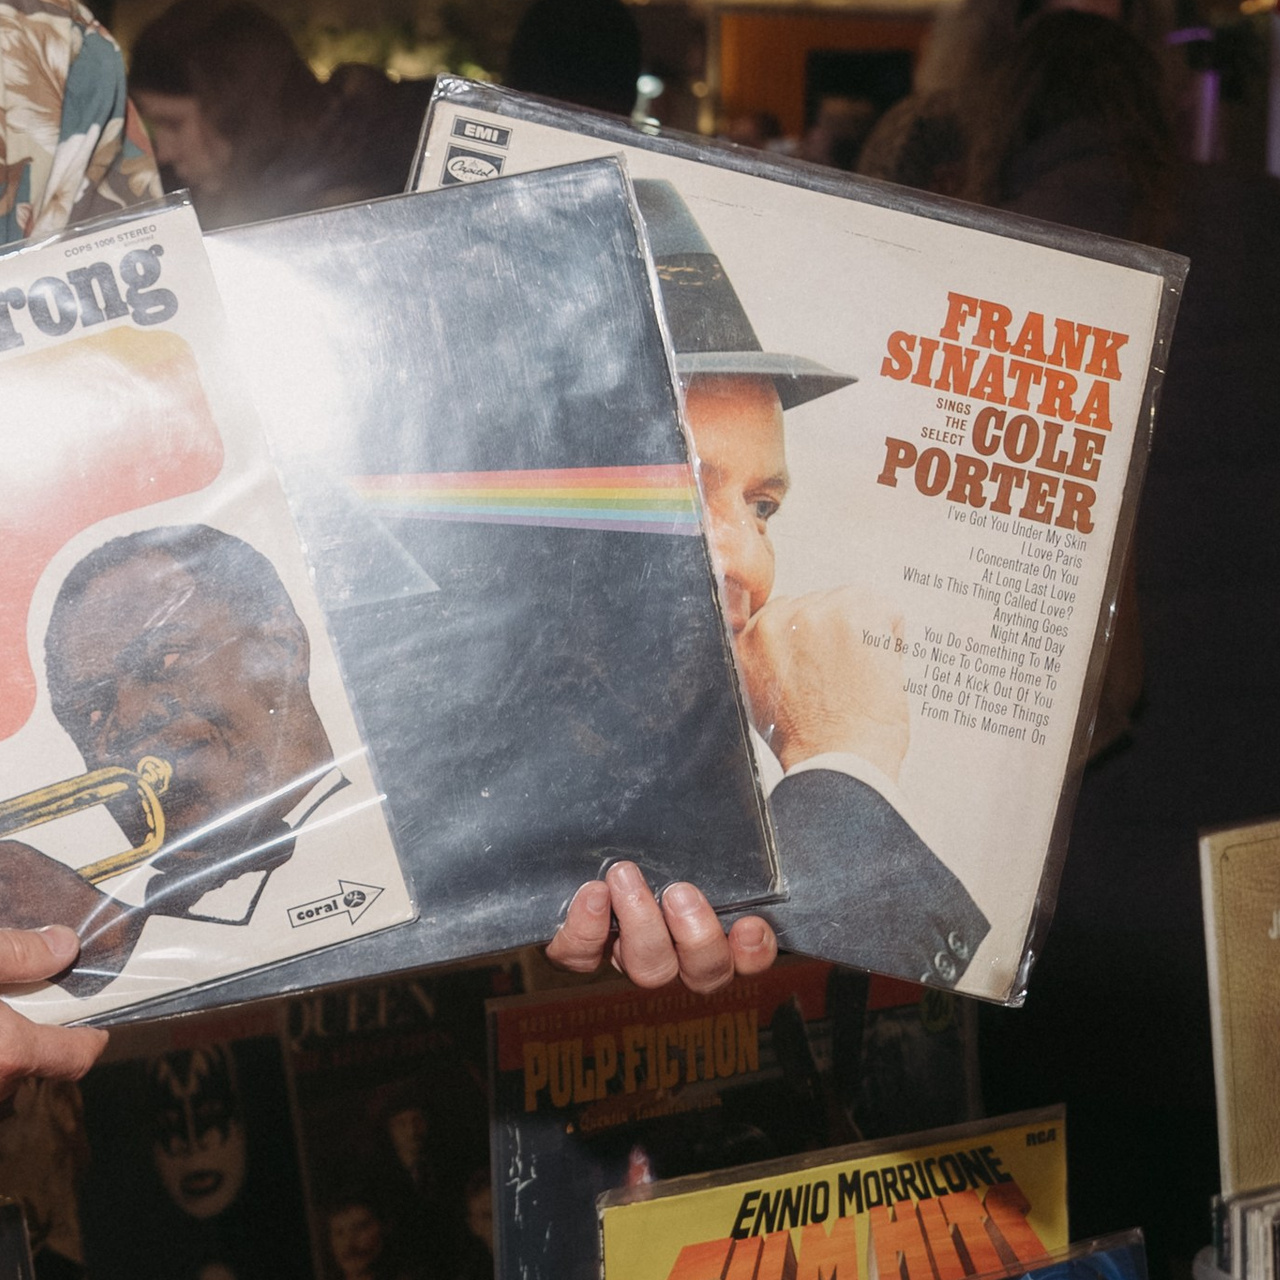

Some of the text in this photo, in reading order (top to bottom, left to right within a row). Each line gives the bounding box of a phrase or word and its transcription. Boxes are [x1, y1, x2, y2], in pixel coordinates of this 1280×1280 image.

[464, 123, 499, 142] EMI
[451, 160, 494, 177] Capitol
[65, 244, 92, 257] COPS
[117, 225, 156, 242] STEREO
[940, 291, 1129, 381] FRANK
[880, 331, 1113, 431] SINATRA
[936, 397, 971, 415] SINGS
[945, 416, 967, 431] THE
[921, 427, 965, 446] SELECT
[972, 406, 1106, 481] COLE
[877, 436, 1096, 534] PORTER
[947, 506, 1087, 551] I've Got You Under My Skin
[969, 547, 1079, 586] I Concentrate On You
[1021, 541, 1083, 569] I Love Paris
[903, 566, 1073, 620] What Is This Thing Called Love?
[982, 568, 1076, 603] At Long Last Love
[990, 624, 1065, 657] Night And Day
[993, 607, 1069, 637] Anything Goes
[862, 629, 1057, 691] You'd Be So Nice To Come Home To
[924, 626, 1061, 673] You Do Something To Me
[903, 678, 1050, 728] Just One Of Those Things
[924, 664, 1053, 709] I Get A Kick Out Of You
[920, 701, 1046, 745] From This Moment On
[297, 900, 338, 920] coral
[524, 1035, 617, 1112] PULP
[621, 1009, 759, 1095] FICTION
[1026, 1129, 1056, 1146] RCA
[731, 1146, 1012, 1240] ENNIO MORRICONE
